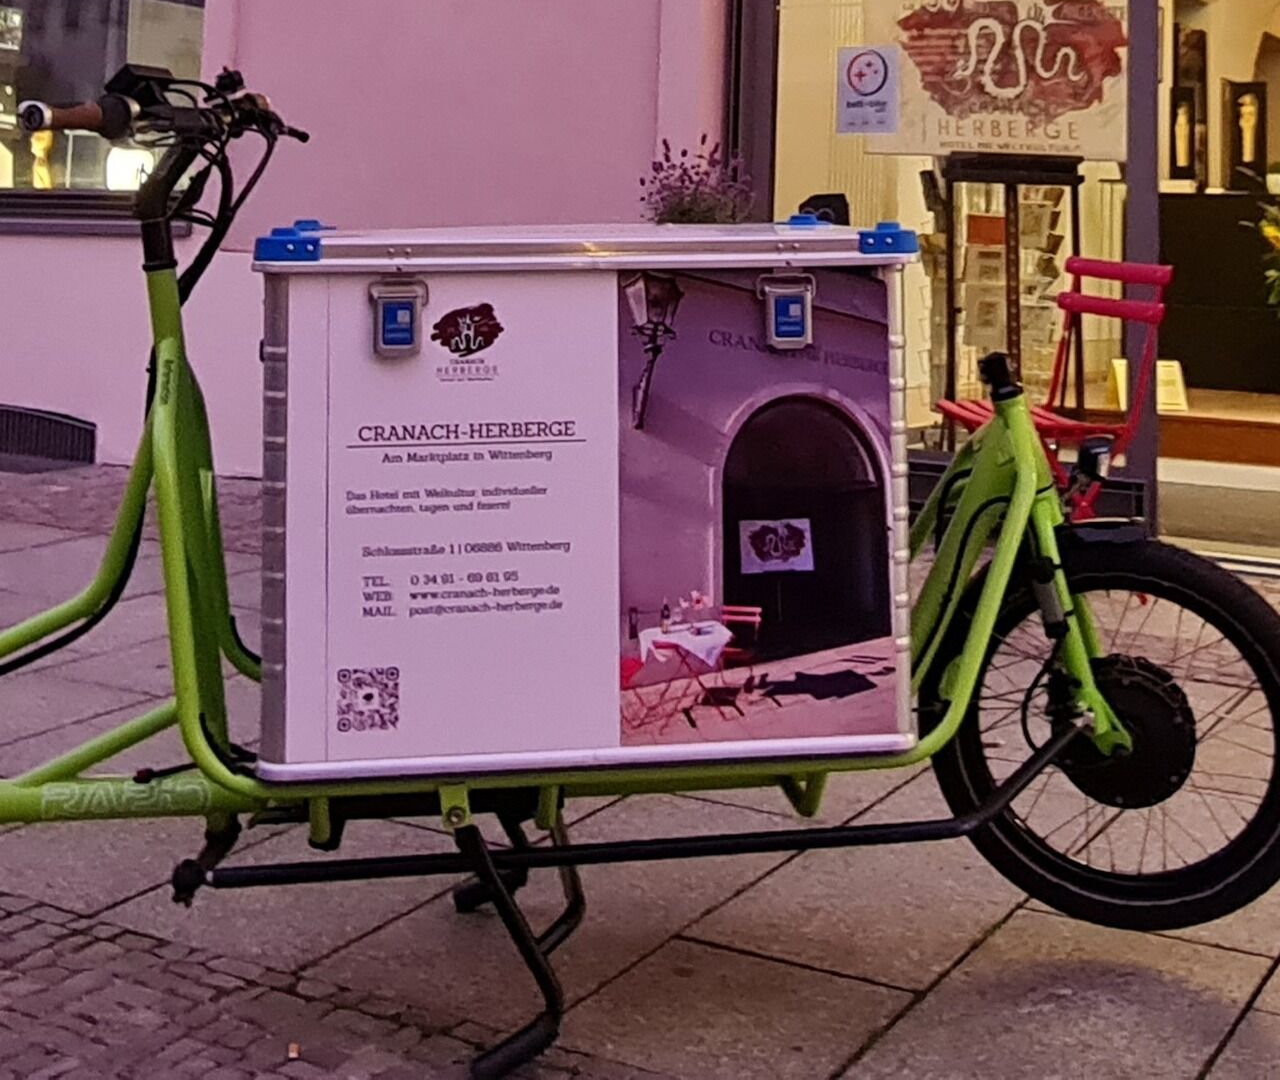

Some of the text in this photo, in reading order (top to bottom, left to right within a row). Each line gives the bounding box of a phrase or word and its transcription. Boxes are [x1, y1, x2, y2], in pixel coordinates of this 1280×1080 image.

[938, 118, 1079, 140] HERBERGE
[358, 421, 576, 443] CRANACH-HERBERGE
[382, 450, 553, 464] Am Marktplatz in Wittenberg
[419, 503, 450, 514] tagen
[453, 502, 474, 511] und
[506, 540, 571, 553] Wittenberg
[423, 573, 437, 585] 34
[409, 585, 560, 599] www.cranach-herberge.de
[409, 600, 563, 618] post@cranach-herberge.de
